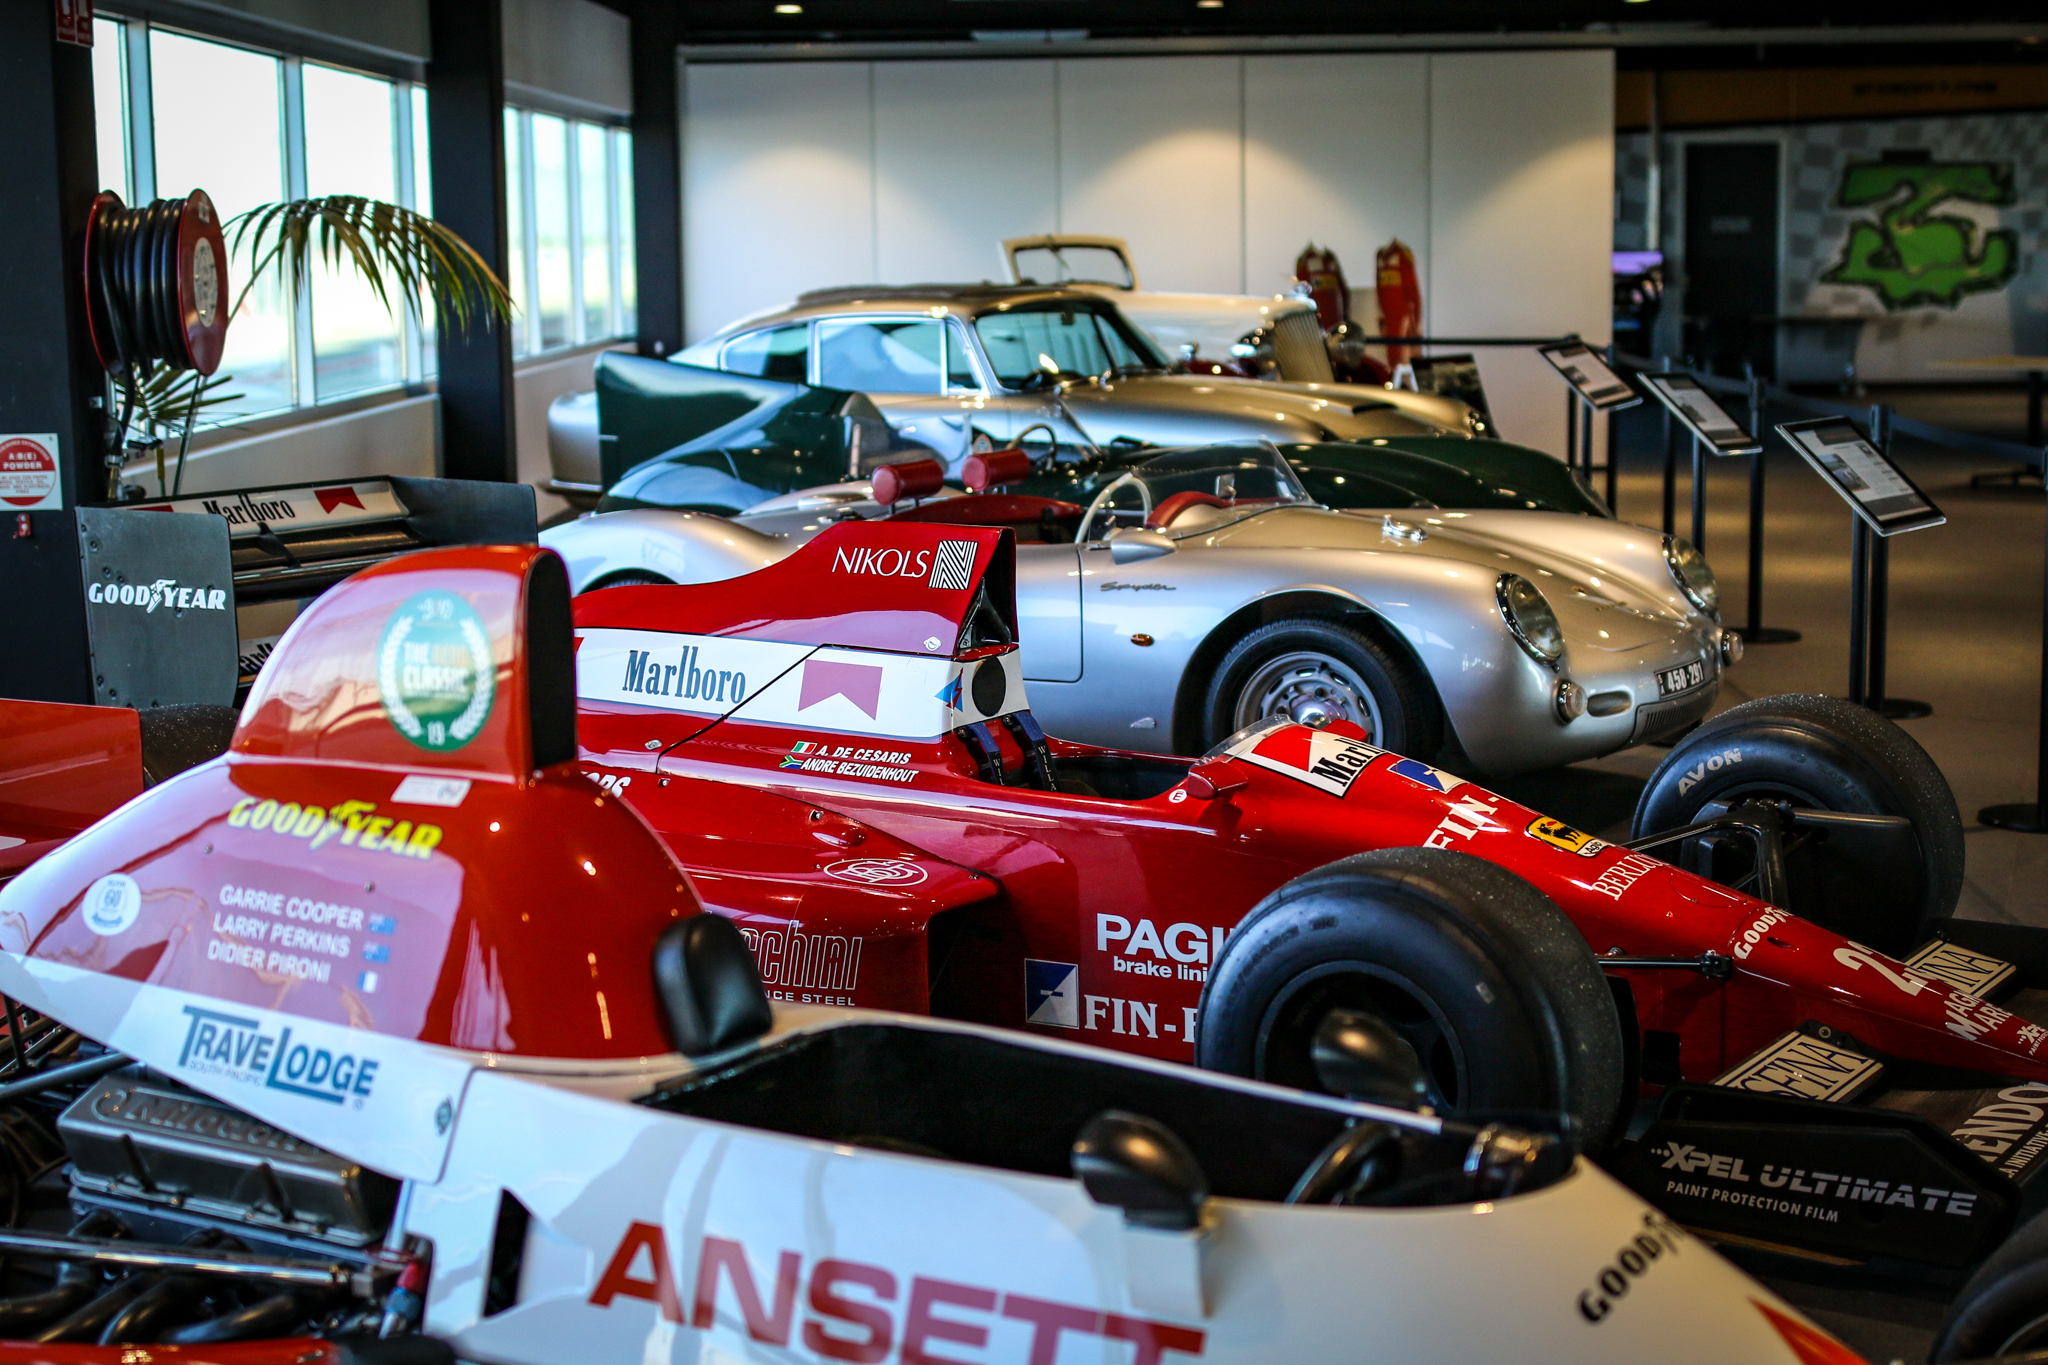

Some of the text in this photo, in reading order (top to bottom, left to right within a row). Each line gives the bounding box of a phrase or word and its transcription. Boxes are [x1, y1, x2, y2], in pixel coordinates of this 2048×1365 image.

[3, 461, 42, 470] POWDER
[202, 492, 296, 525] Marlboro
[832, 546, 931, 578] NIKOLS
[88, 579, 227, 614] GOODYEAR
[1100, 581, 1177, 592] Spyder
[622, 645, 746, 704] Marlboro
[800, 757, 920, 783] ANDRE BEZUIDENHOUT
[815, 745, 912, 765] A. DE CESARIS
[993, 758, 1005, 786] WIL
[1038, 745, 1057, 793] WILLA
[1310, 737, 1386, 788] Marl
[1678, 748, 1743, 797] AVON
[227, 797, 443, 860] GOODYEAR
[219, 884, 365, 932] GARRIE COOPER
[212, 911, 351, 958] LARRY PERKINS
[1097, 912, 1236, 964] PAGI
[207, 938, 332, 984] DIDIER PIRONI
[1113, 955, 1209, 983] brake lini
[1917, 950, 2005, 988] INA
[801, 993, 856, 1006] STEEL
[1661, 1141, 1978, 1217] XPEL ULTIMATE
[1666, 1180, 1839, 1223] PAINT PROTECTION FILM
